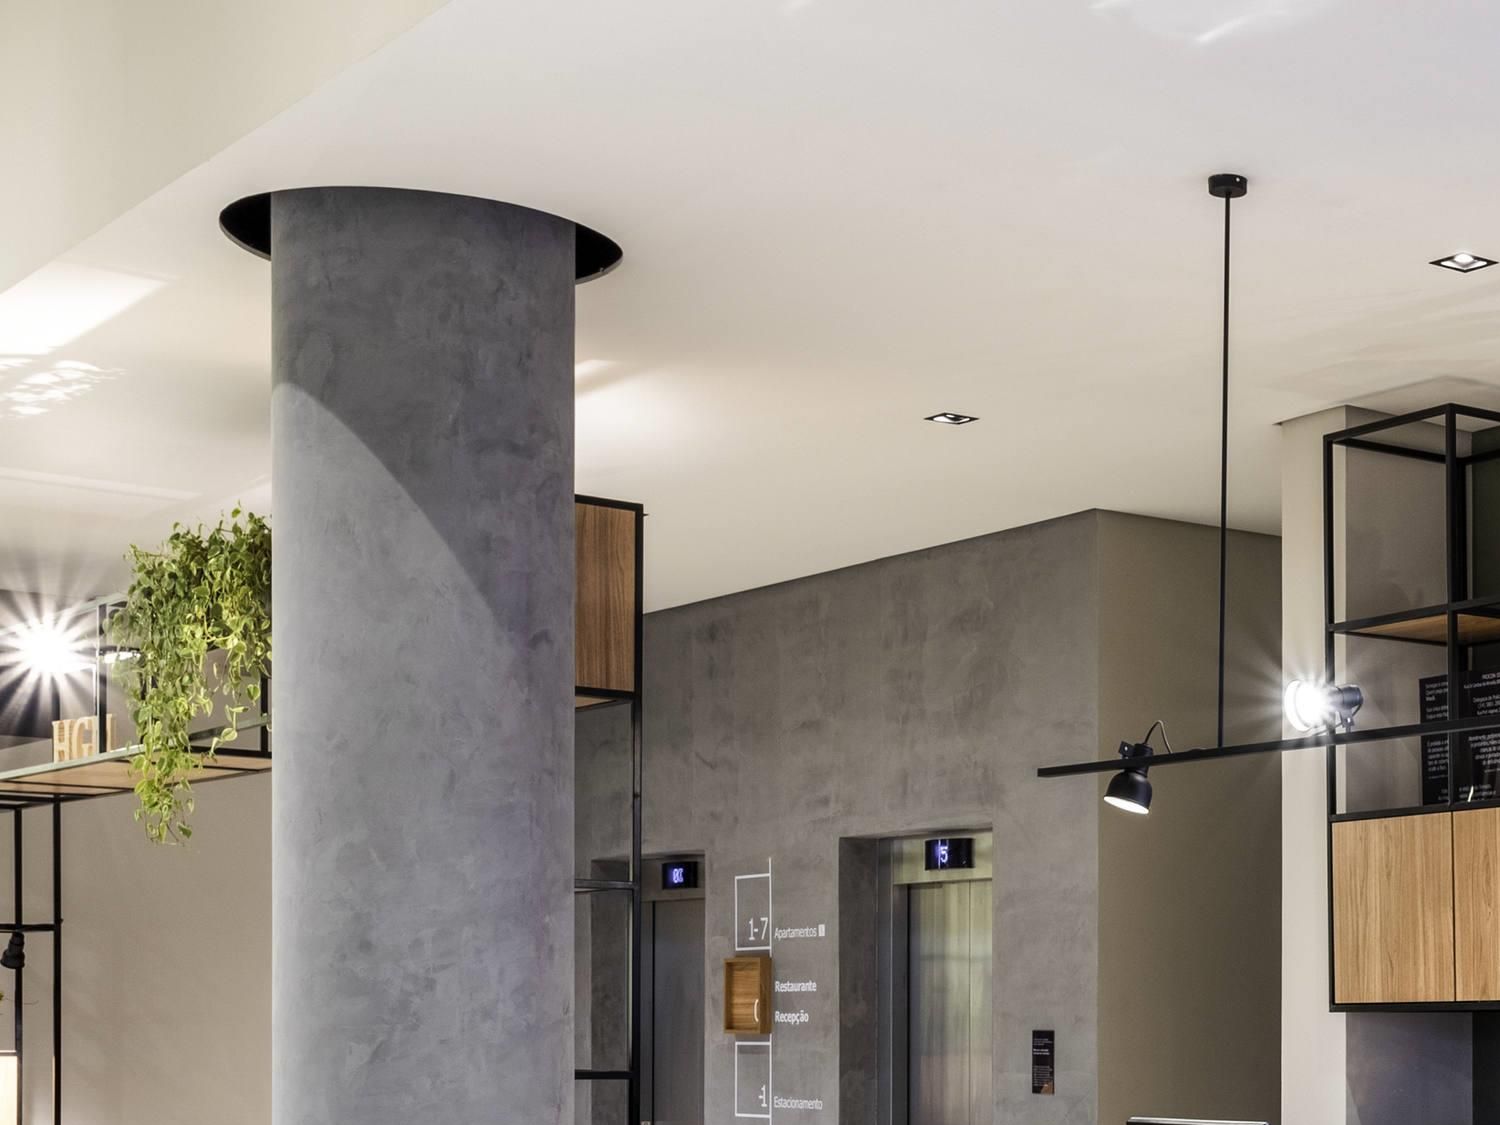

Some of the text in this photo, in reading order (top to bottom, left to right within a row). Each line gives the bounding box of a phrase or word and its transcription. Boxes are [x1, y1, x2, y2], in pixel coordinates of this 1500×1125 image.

[774, 926, 818, 941] Apartamentos
[774, 980, 817, 993] Restaurante
[774, 1009, 810, 1026] Recepção
[773, 1095, 823, 1110] Estacionamento
